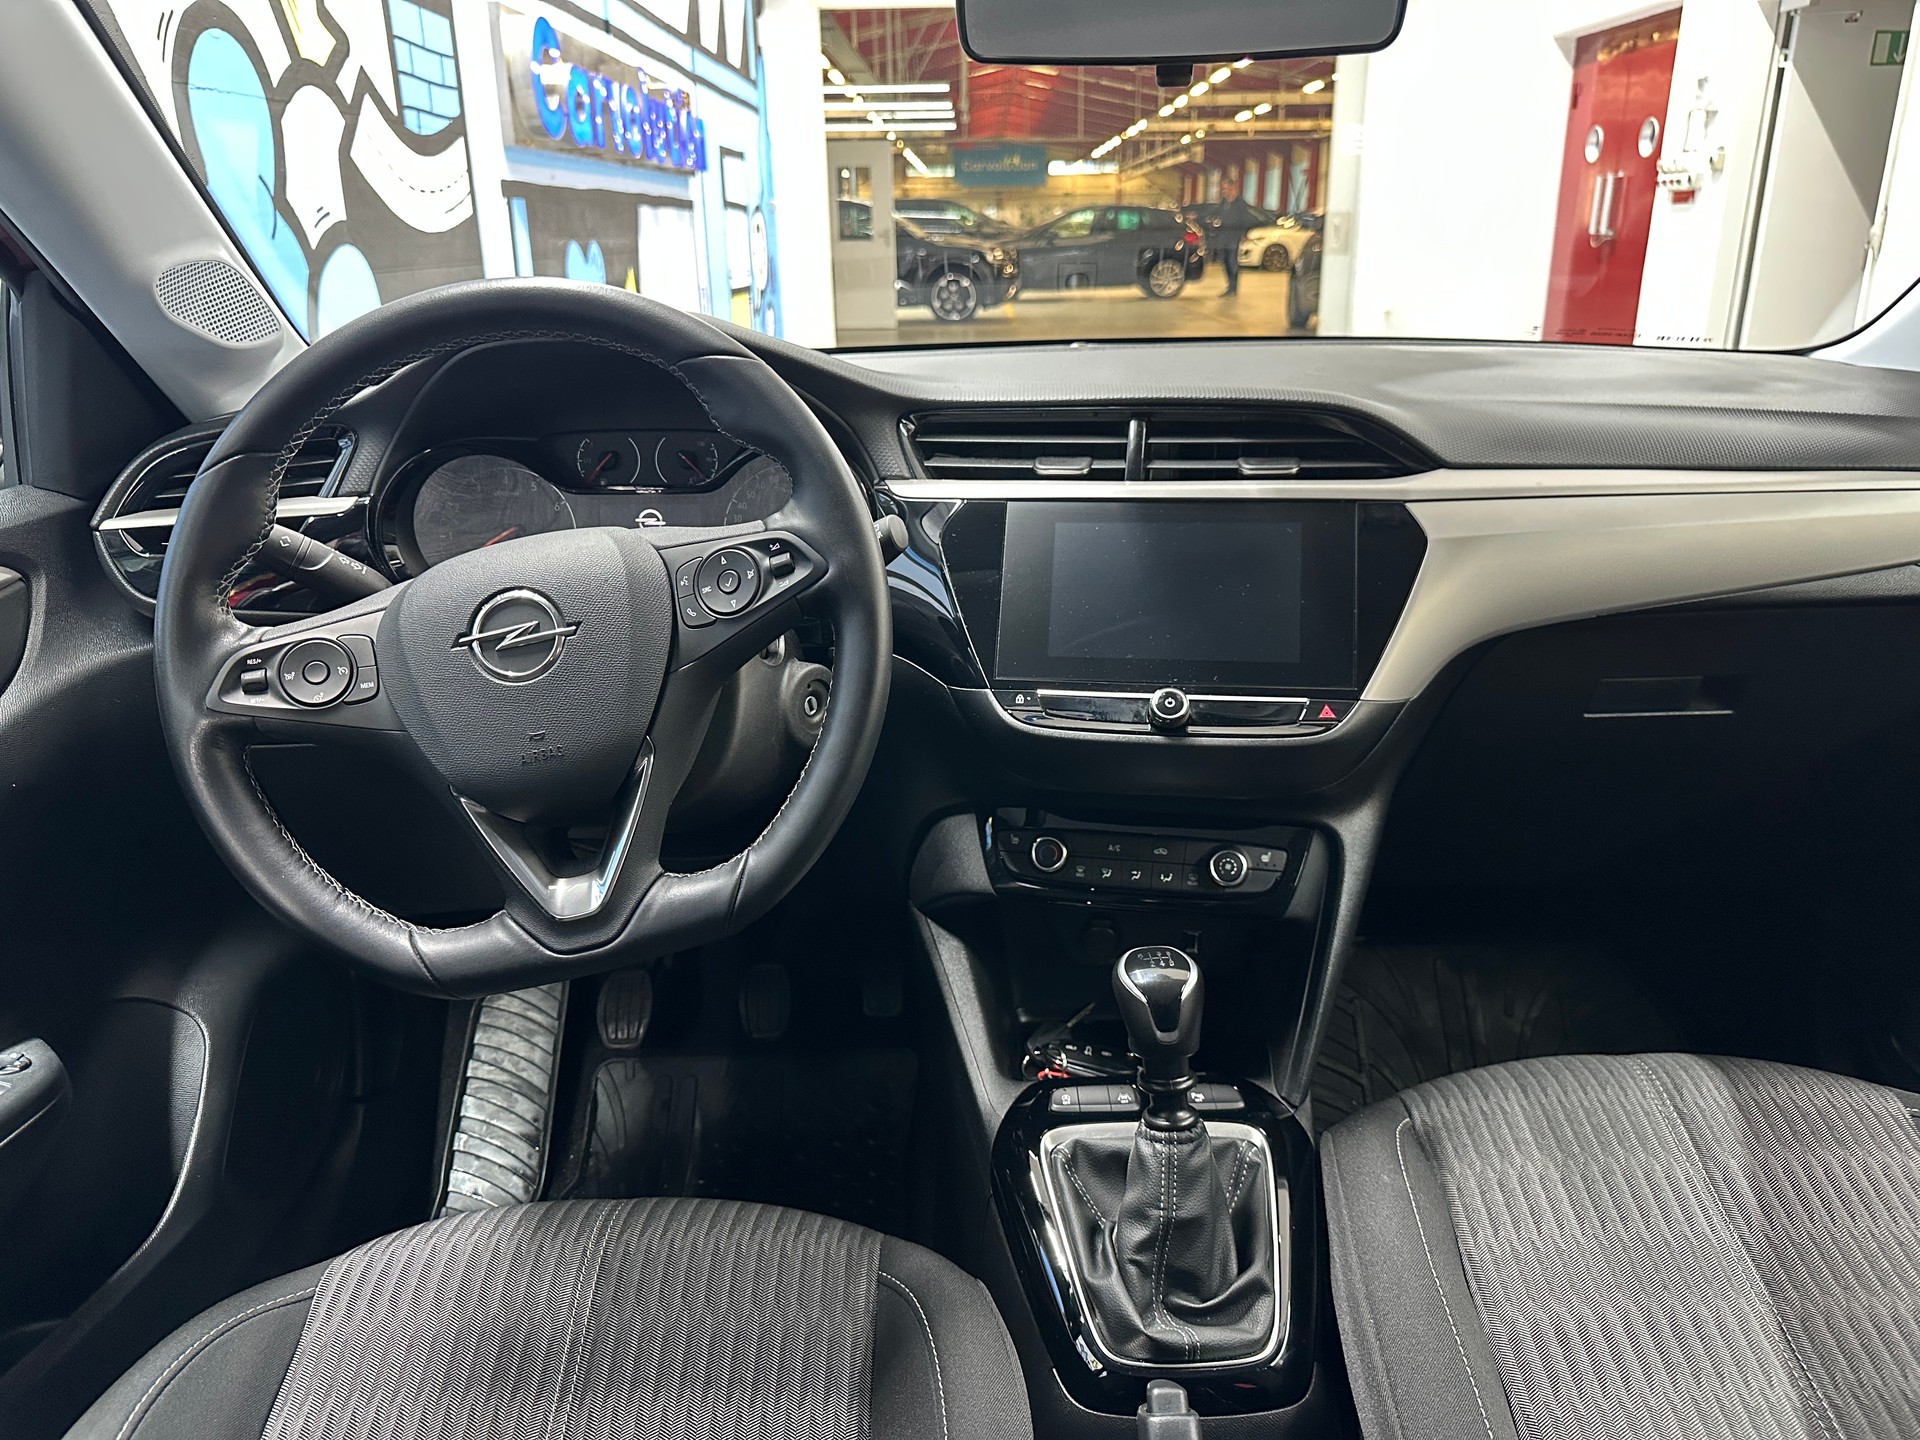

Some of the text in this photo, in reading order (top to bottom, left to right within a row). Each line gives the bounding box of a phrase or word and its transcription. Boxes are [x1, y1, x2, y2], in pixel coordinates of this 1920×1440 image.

[530, 481, 538, 492] 5
[553, 502, 561, 512] 6
[360, 681, 374, 689] MEM
